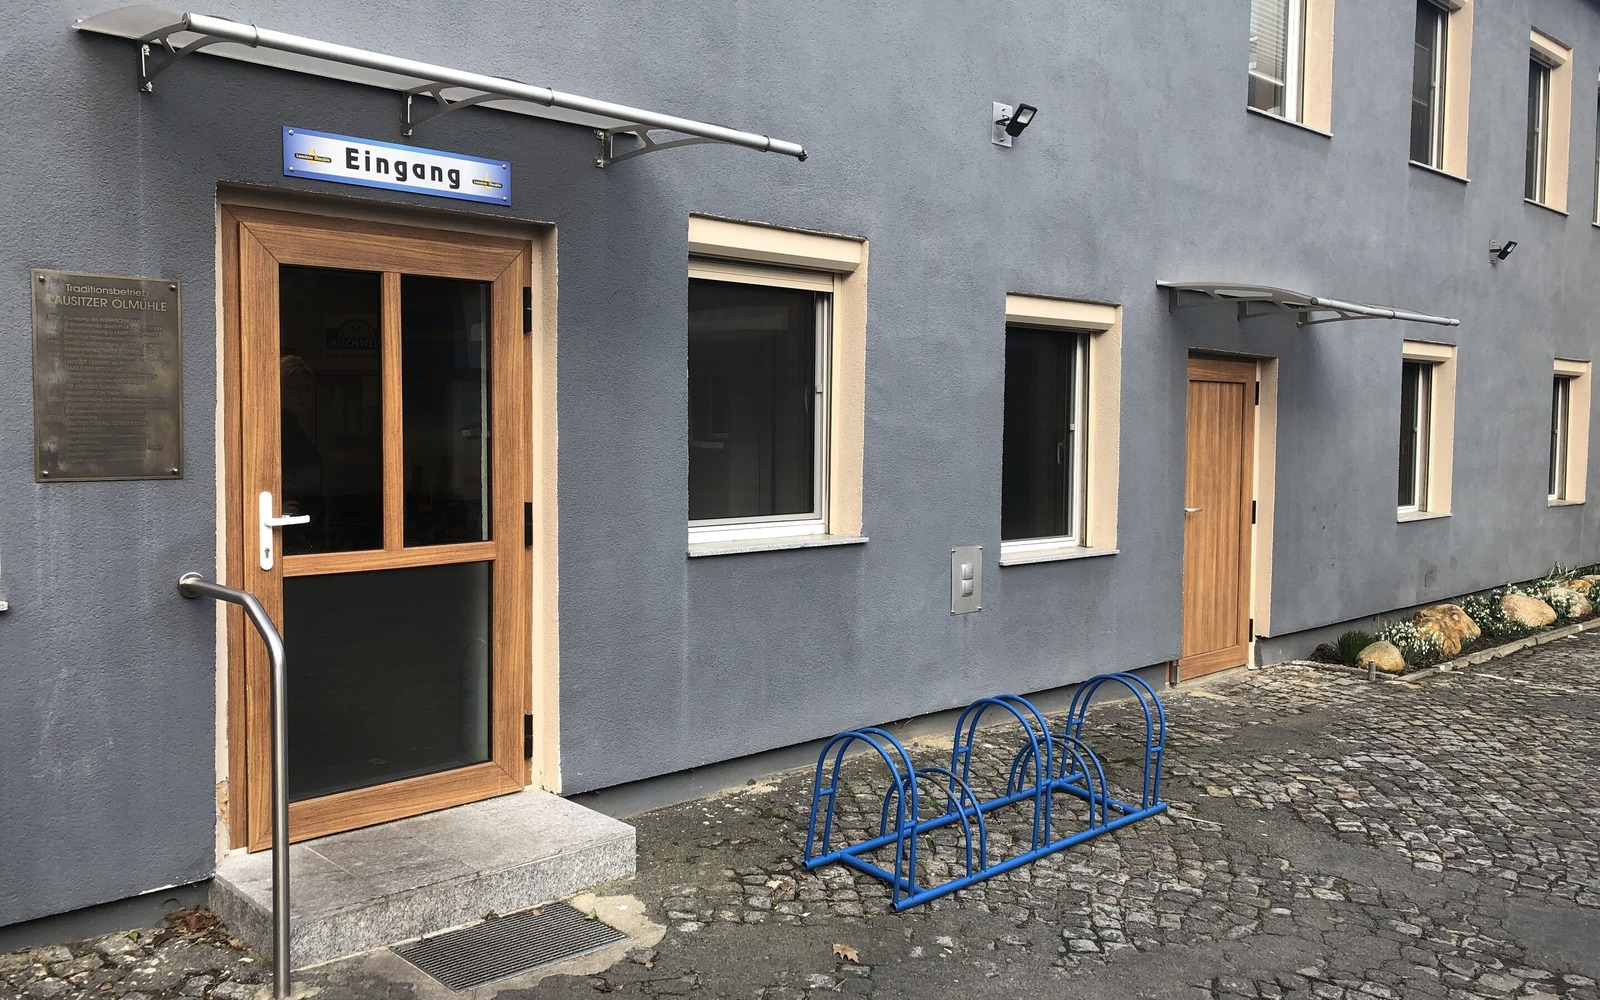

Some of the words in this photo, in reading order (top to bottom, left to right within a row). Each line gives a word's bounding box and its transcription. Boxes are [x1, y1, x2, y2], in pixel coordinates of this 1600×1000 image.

[345, 147, 461, 190] Eingang
[65, 283, 149, 297] Traditionsbetrieb
[47, 294, 108, 308] LAUSITZER
[111, 296, 168, 312] ÖLMÜHLE
[328, 338, 377, 349] MILCHWEL
